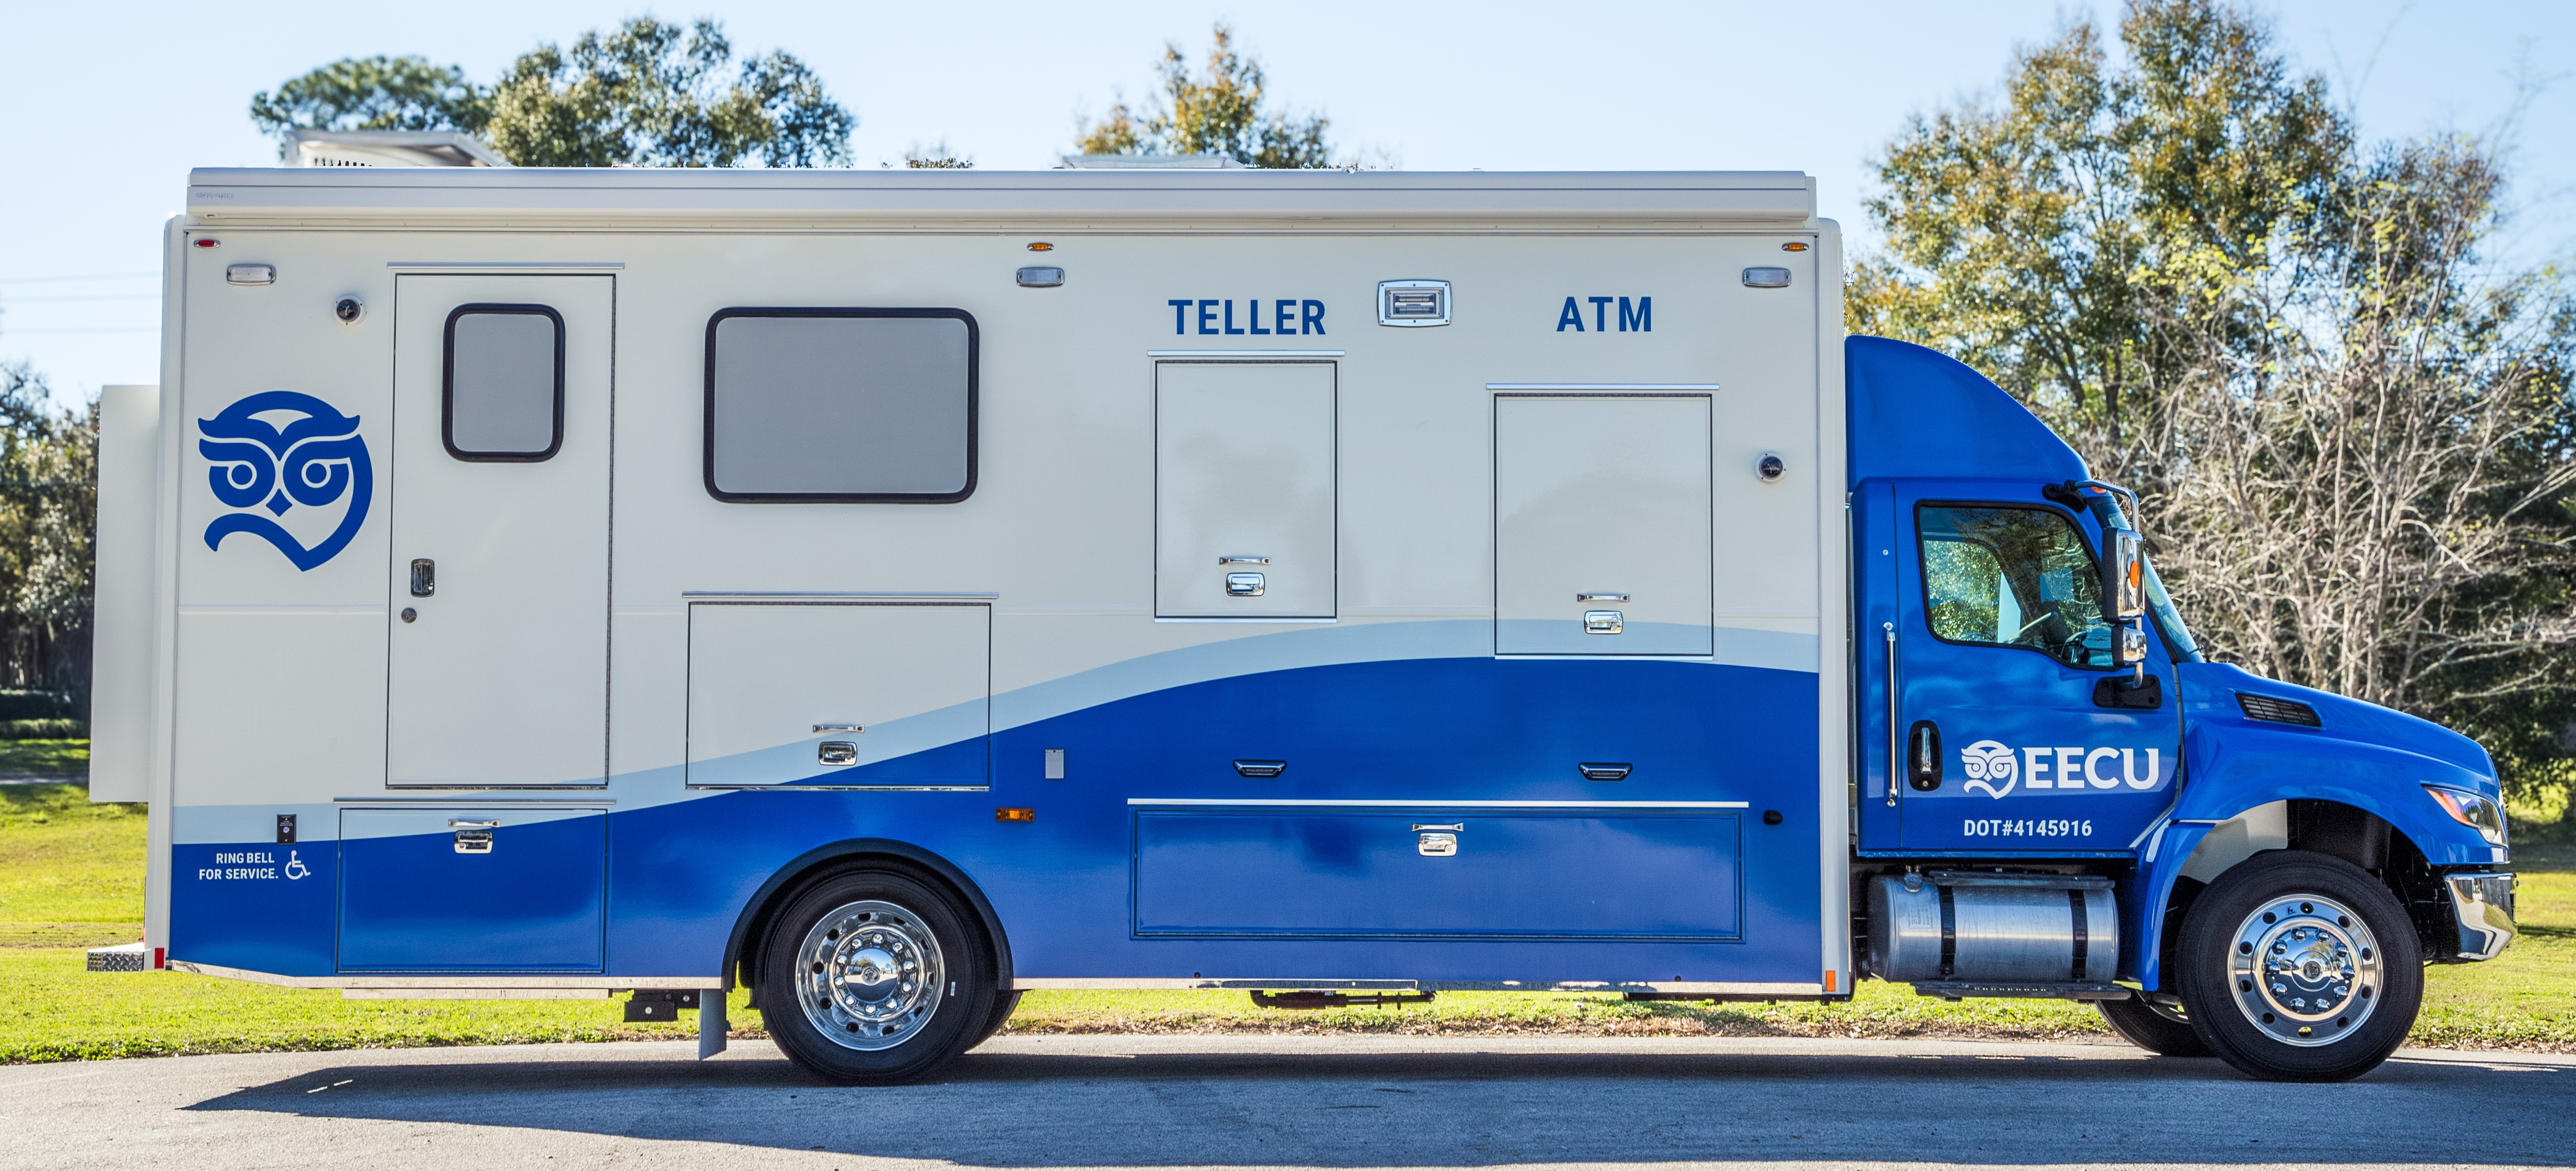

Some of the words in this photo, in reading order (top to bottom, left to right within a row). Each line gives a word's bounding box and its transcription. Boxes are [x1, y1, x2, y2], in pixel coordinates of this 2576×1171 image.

[1168, 299, 1326, 335] TELLER
[1556, 296, 1651, 332] ATM
[2022, 747, 2159, 790] EECU
[1964, 820, 2092, 836] DOT#4145916
[216, 853, 244, 864] RING
[246, 852, 275, 863] BELL
[199, 869, 222, 880] FOR
[226, 868, 278, 879] SERVICE.
